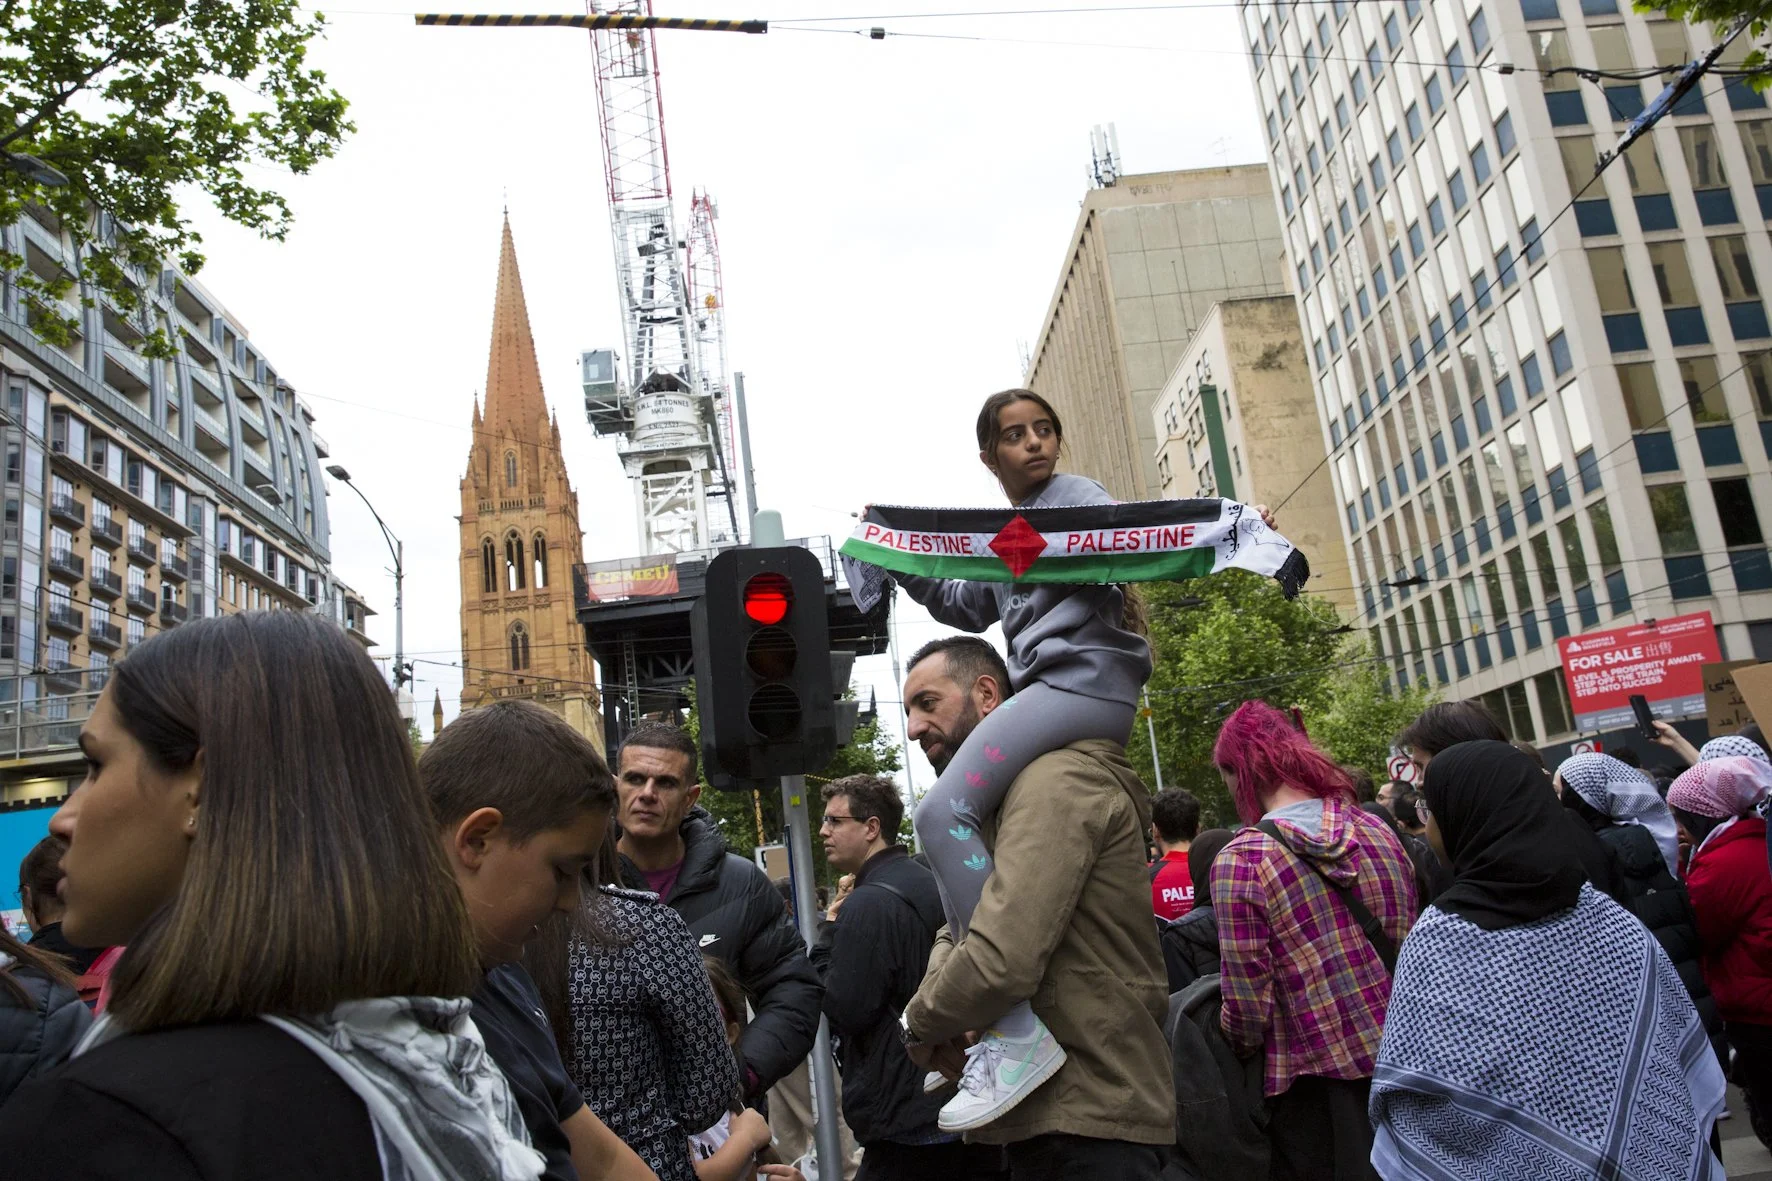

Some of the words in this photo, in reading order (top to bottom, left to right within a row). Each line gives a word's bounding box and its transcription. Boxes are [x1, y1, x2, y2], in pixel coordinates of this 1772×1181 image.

[865, 524, 973, 555] PALESTINE
[1067, 525, 1196, 553] PALESTINE
[1570, 655, 1602, 671] FOR
[1603, 647, 1644, 664] SALE
[1573, 671, 1601, 682] LEVEL
[1611, 660, 1666, 676] PROSPERITY
[1667, 652, 1706, 666] AWAITS.
[1574, 680, 1597, 690] STEP
[1597, 676, 1615, 686] OFF
[1617, 672, 1635, 682] THE
[1576, 686, 1598, 697] STEP
[1599, 683, 1621, 693] INTO
[1621, 677, 1663, 689] SUCCESS
